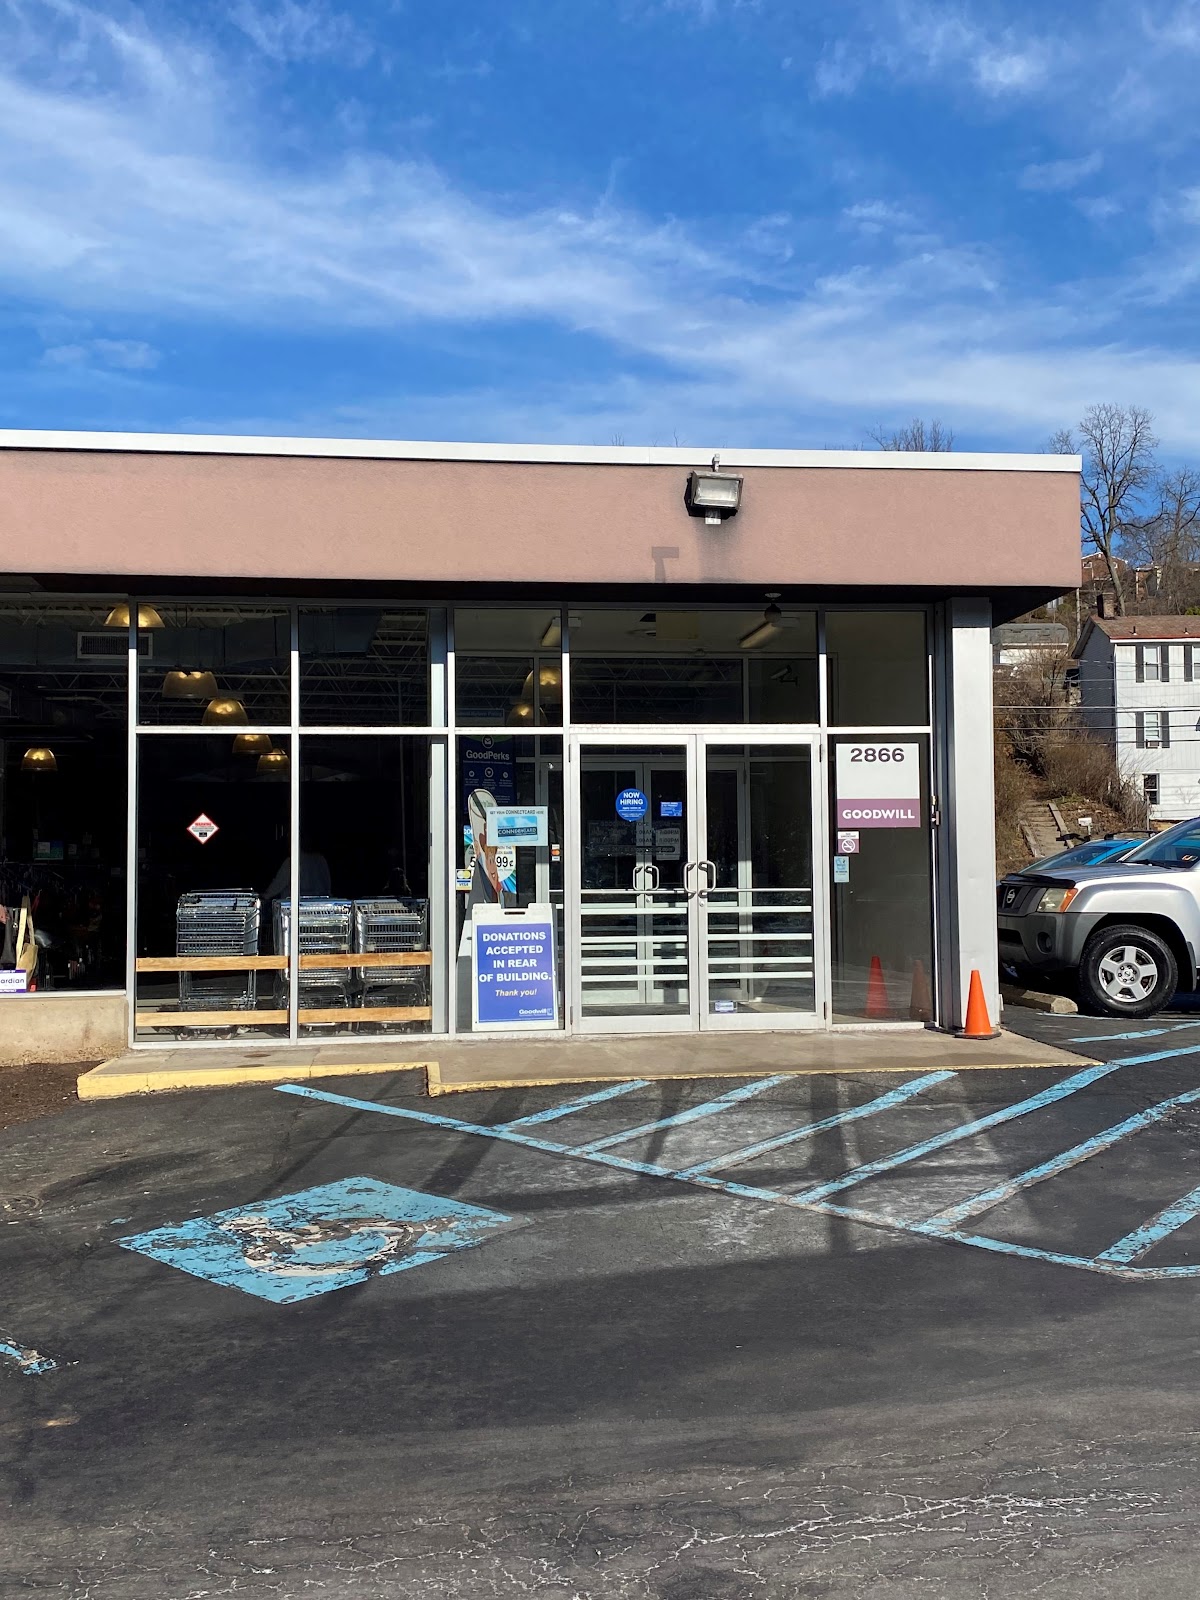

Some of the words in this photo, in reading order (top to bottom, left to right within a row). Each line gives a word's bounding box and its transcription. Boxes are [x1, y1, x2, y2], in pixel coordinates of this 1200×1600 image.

[465, 749, 510, 761] GoodPerks
[850, 747, 905, 762] 2866
[842, 809, 915, 819] GOODWILL
[482, 931, 547, 942] DONATIONS
[486, 945, 544, 955] ACCEPTED
[493, 959, 505, 969] IN
[507, 958, 538, 968] REAR
[478, 973, 494, 983] OF
[496, 971, 552, 983] BUILDING.
[495, 989, 519, 997] Thank
[519, 988, 538, 998] you!
